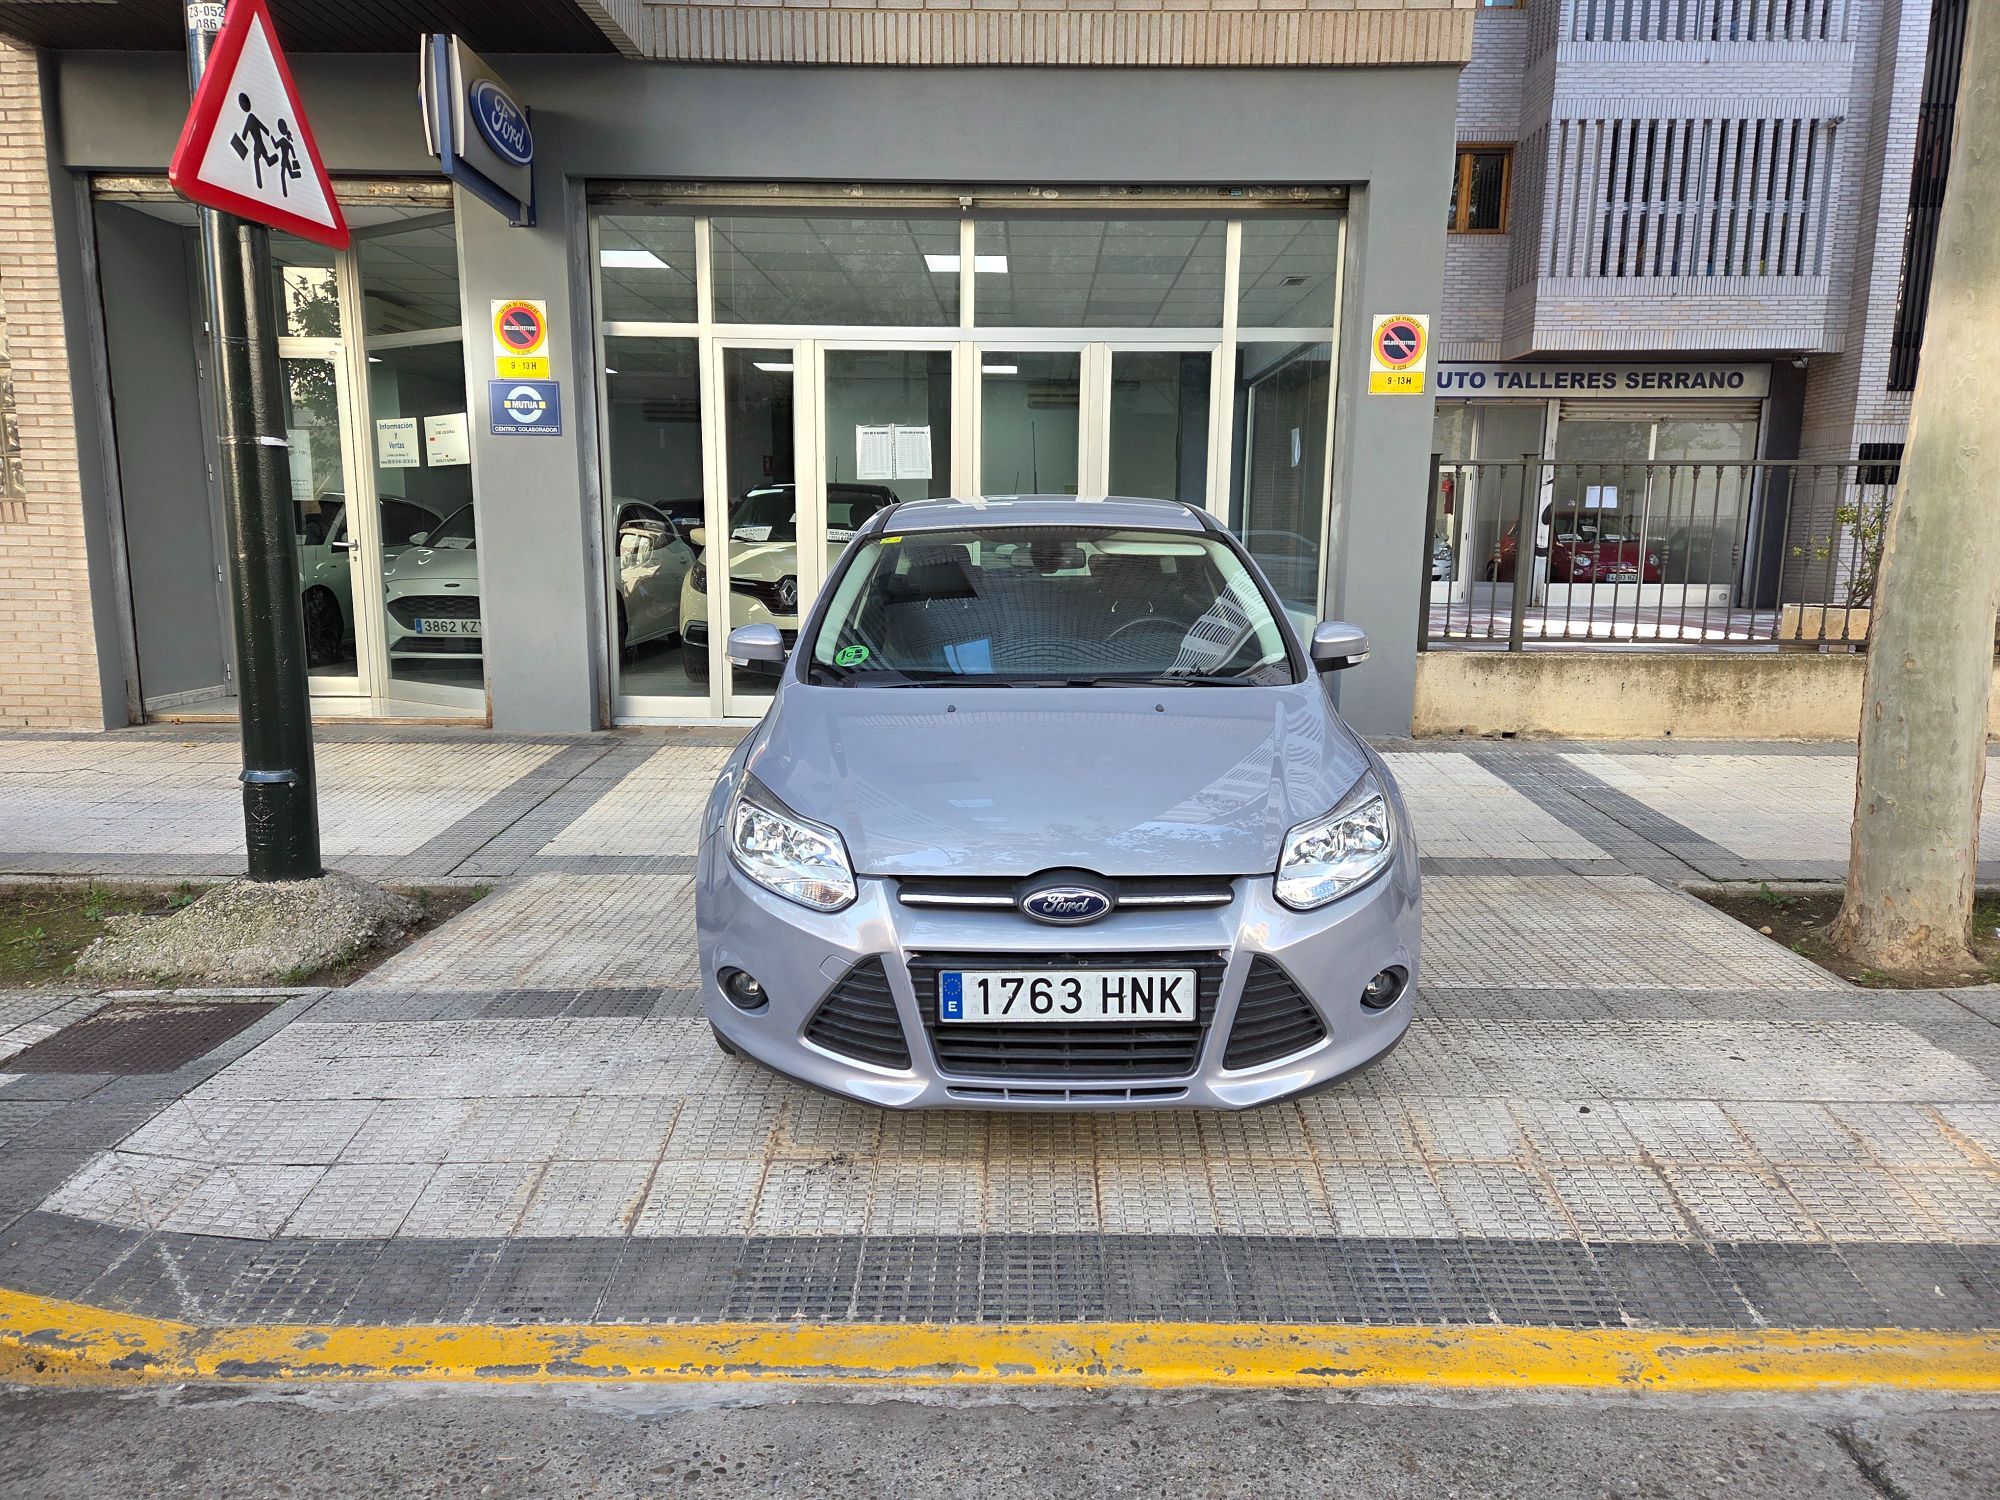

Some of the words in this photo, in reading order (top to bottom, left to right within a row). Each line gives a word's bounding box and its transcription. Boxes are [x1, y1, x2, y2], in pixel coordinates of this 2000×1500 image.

[491, 95, 524, 153] Ford
[510, 362, 516, 370] 9
[1436, 372, 1486, 388] UTO
[1494, 372, 1616, 389] TALLERES
[1624, 372, 1744, 389] SERRANO
[512, 400, 538, 408] MUTUA
[424, 620, 456, 632] 3862
[1042, 893, 1090, 913] Ford
[948, 1001, 958, 1012] E
[977, 977, 1082, 1014] 1763
[1102, 976, 1182, 1014] HNK
